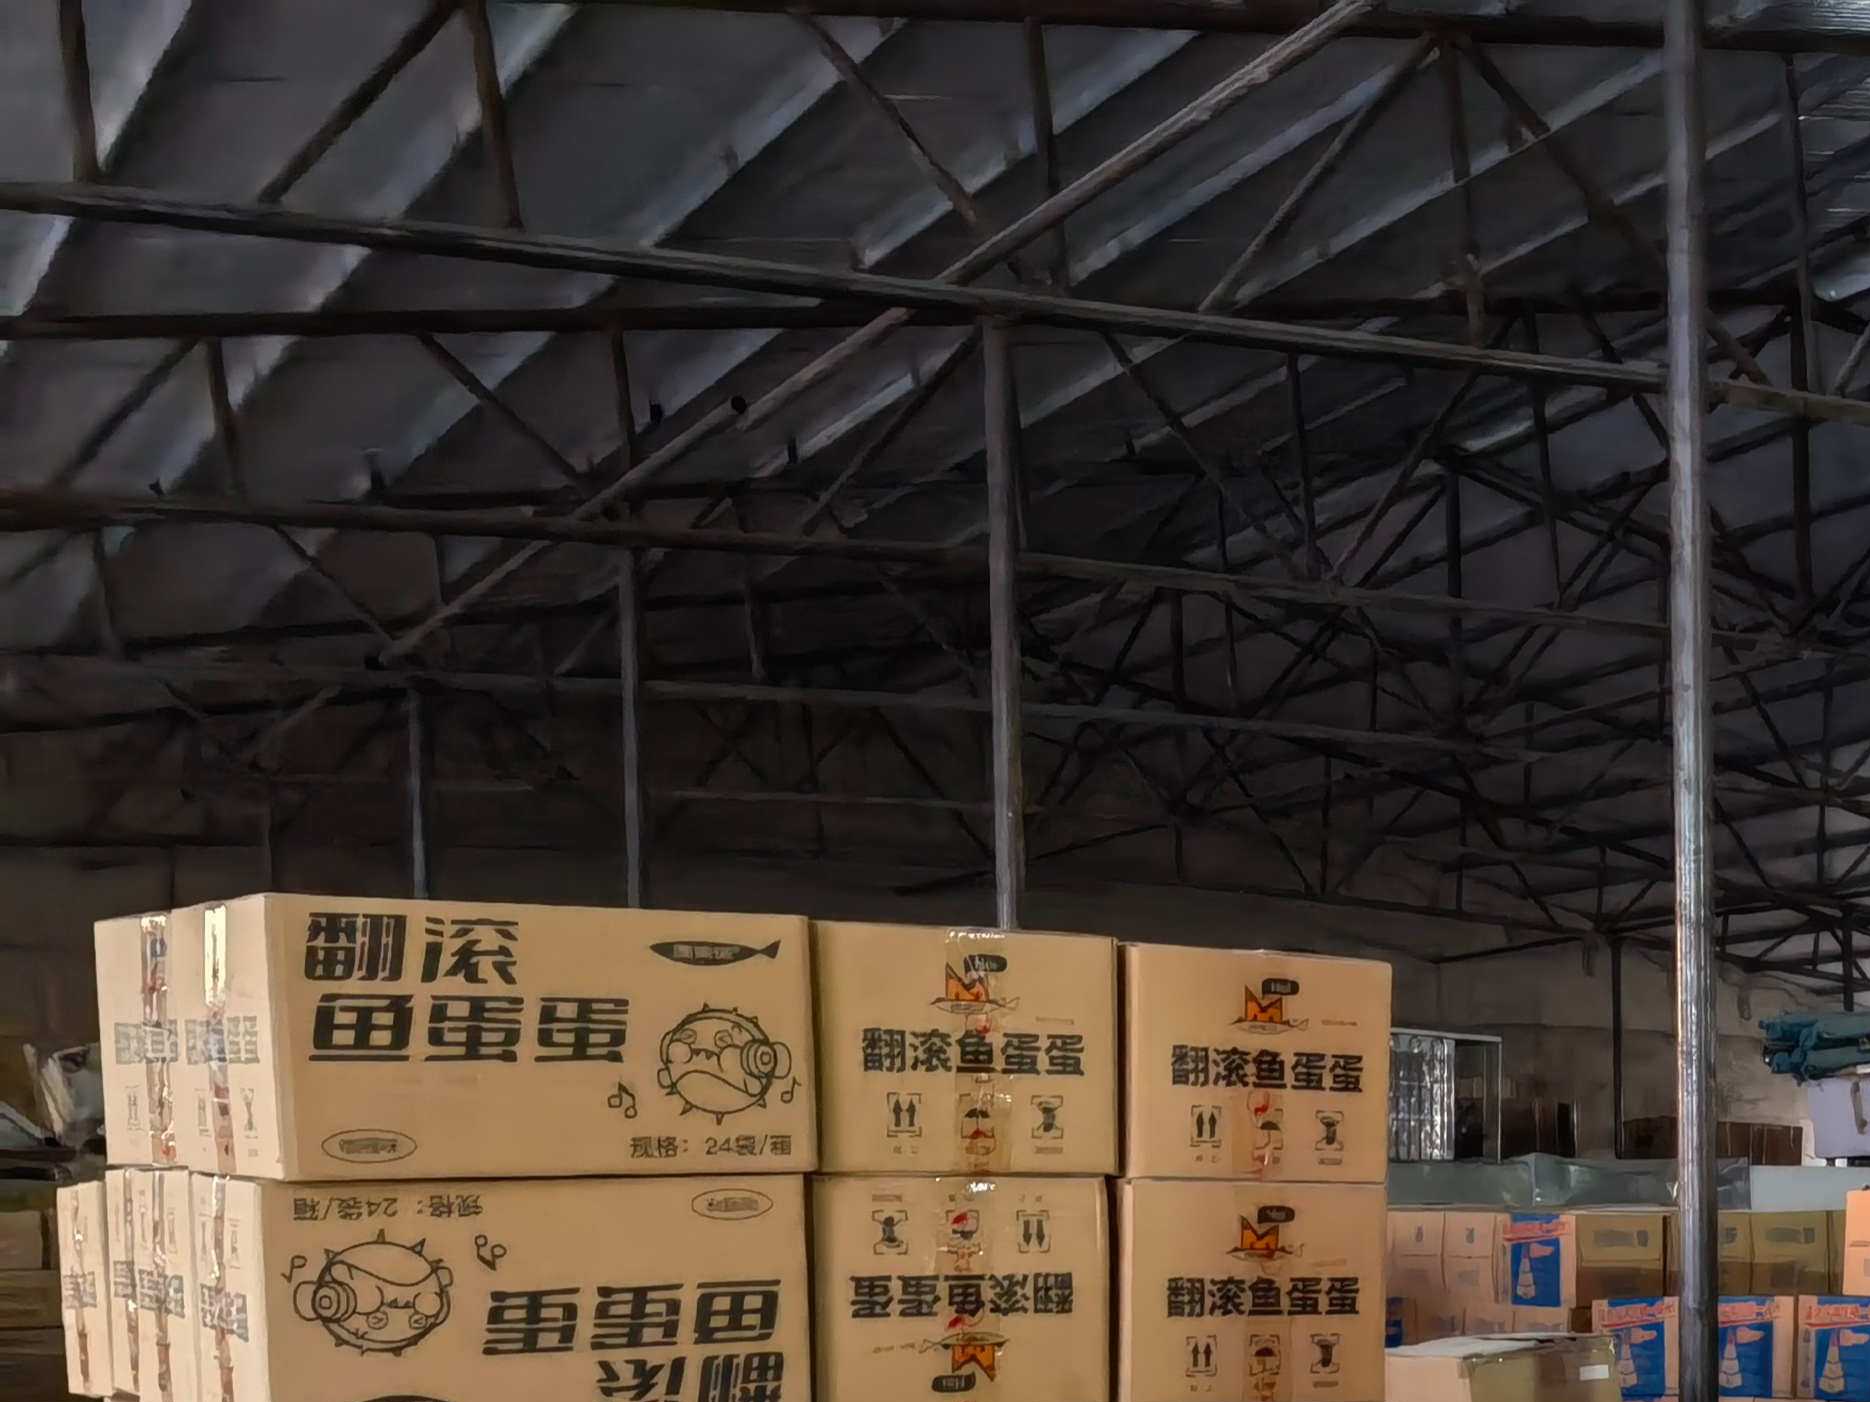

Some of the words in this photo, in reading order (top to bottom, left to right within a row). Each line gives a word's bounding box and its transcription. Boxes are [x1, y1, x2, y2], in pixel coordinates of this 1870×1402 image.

[304, 912, 520, 985] 翻滚
[309, 993, 630, 1063] 鱼蛋蛋
[861, 1027, 1085, 1077] 翻滚鱼蛋蛋
[1170, 1044, 1364, 1094] 翻滚鱼蛋蛋
[481, 1279, 782, 1356] 鱼蛋蛋
[849, 1272, 1075, 1320] 翻滚鱼蛋蛋
[1166, 1276, 1360, 1318] 翻滚鱼蛋蛋
